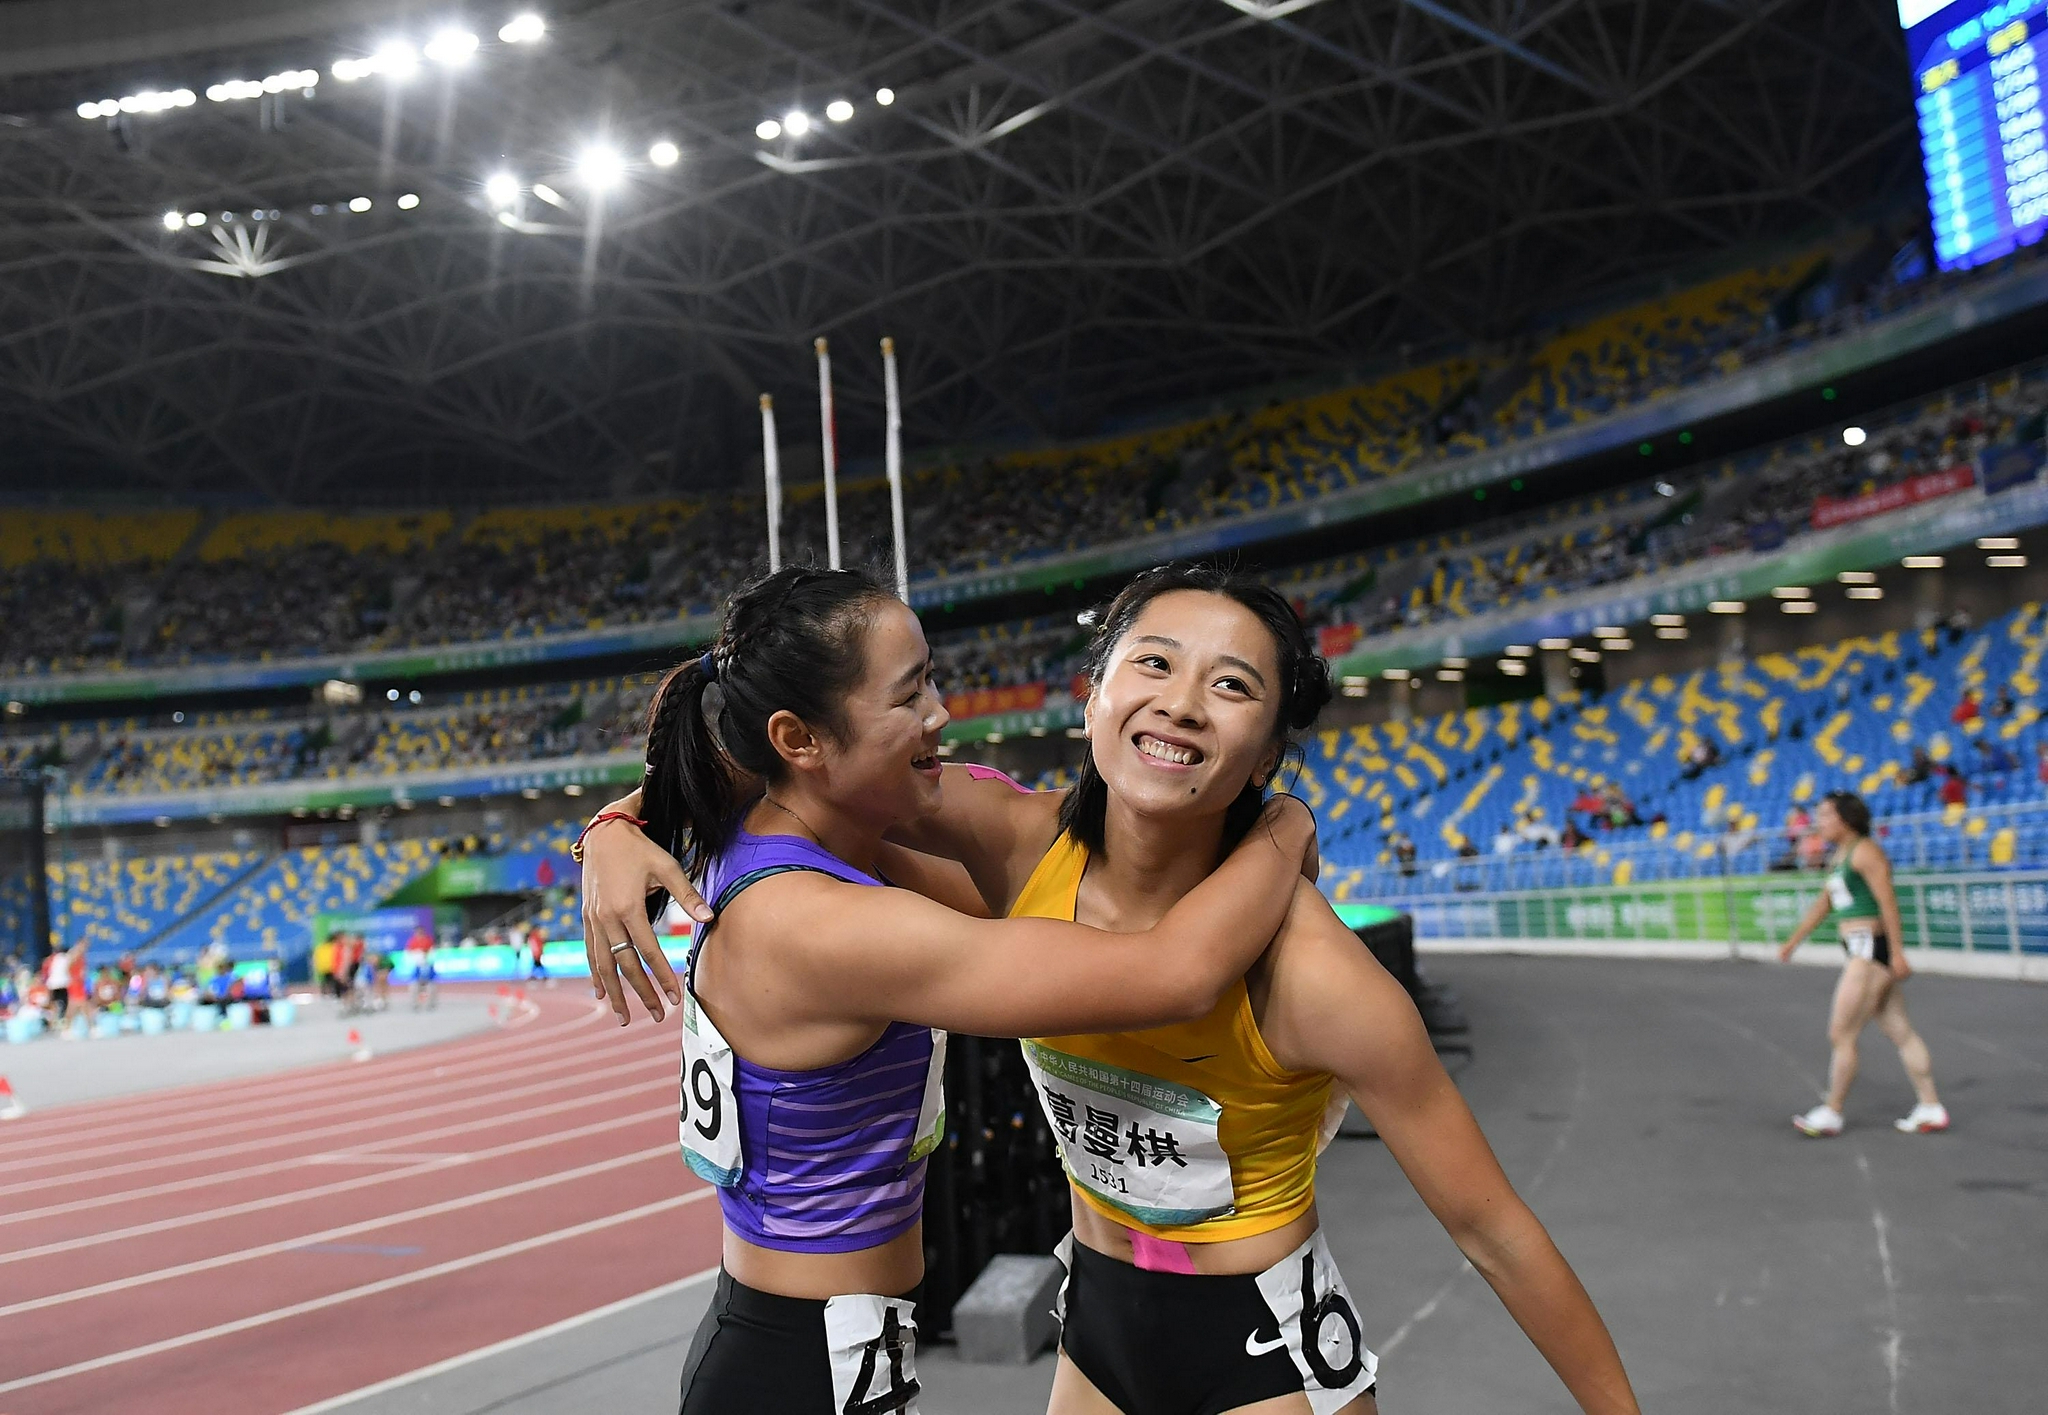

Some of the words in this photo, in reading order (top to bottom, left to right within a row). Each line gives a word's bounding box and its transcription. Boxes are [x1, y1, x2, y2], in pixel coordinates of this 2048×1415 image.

[1040, 1051, 1189, 1108] 中华人民共和国第十四届运动会
[1164, 1106, 1186, 1116] CHINA
[1042, 1084, 1188, 1168] 葛曼棋
[1091, 1163, 1129, 1193] 1531
[1300, 1248, 1361, 1389] 6
[843, 1306, 920, 1415] 4
